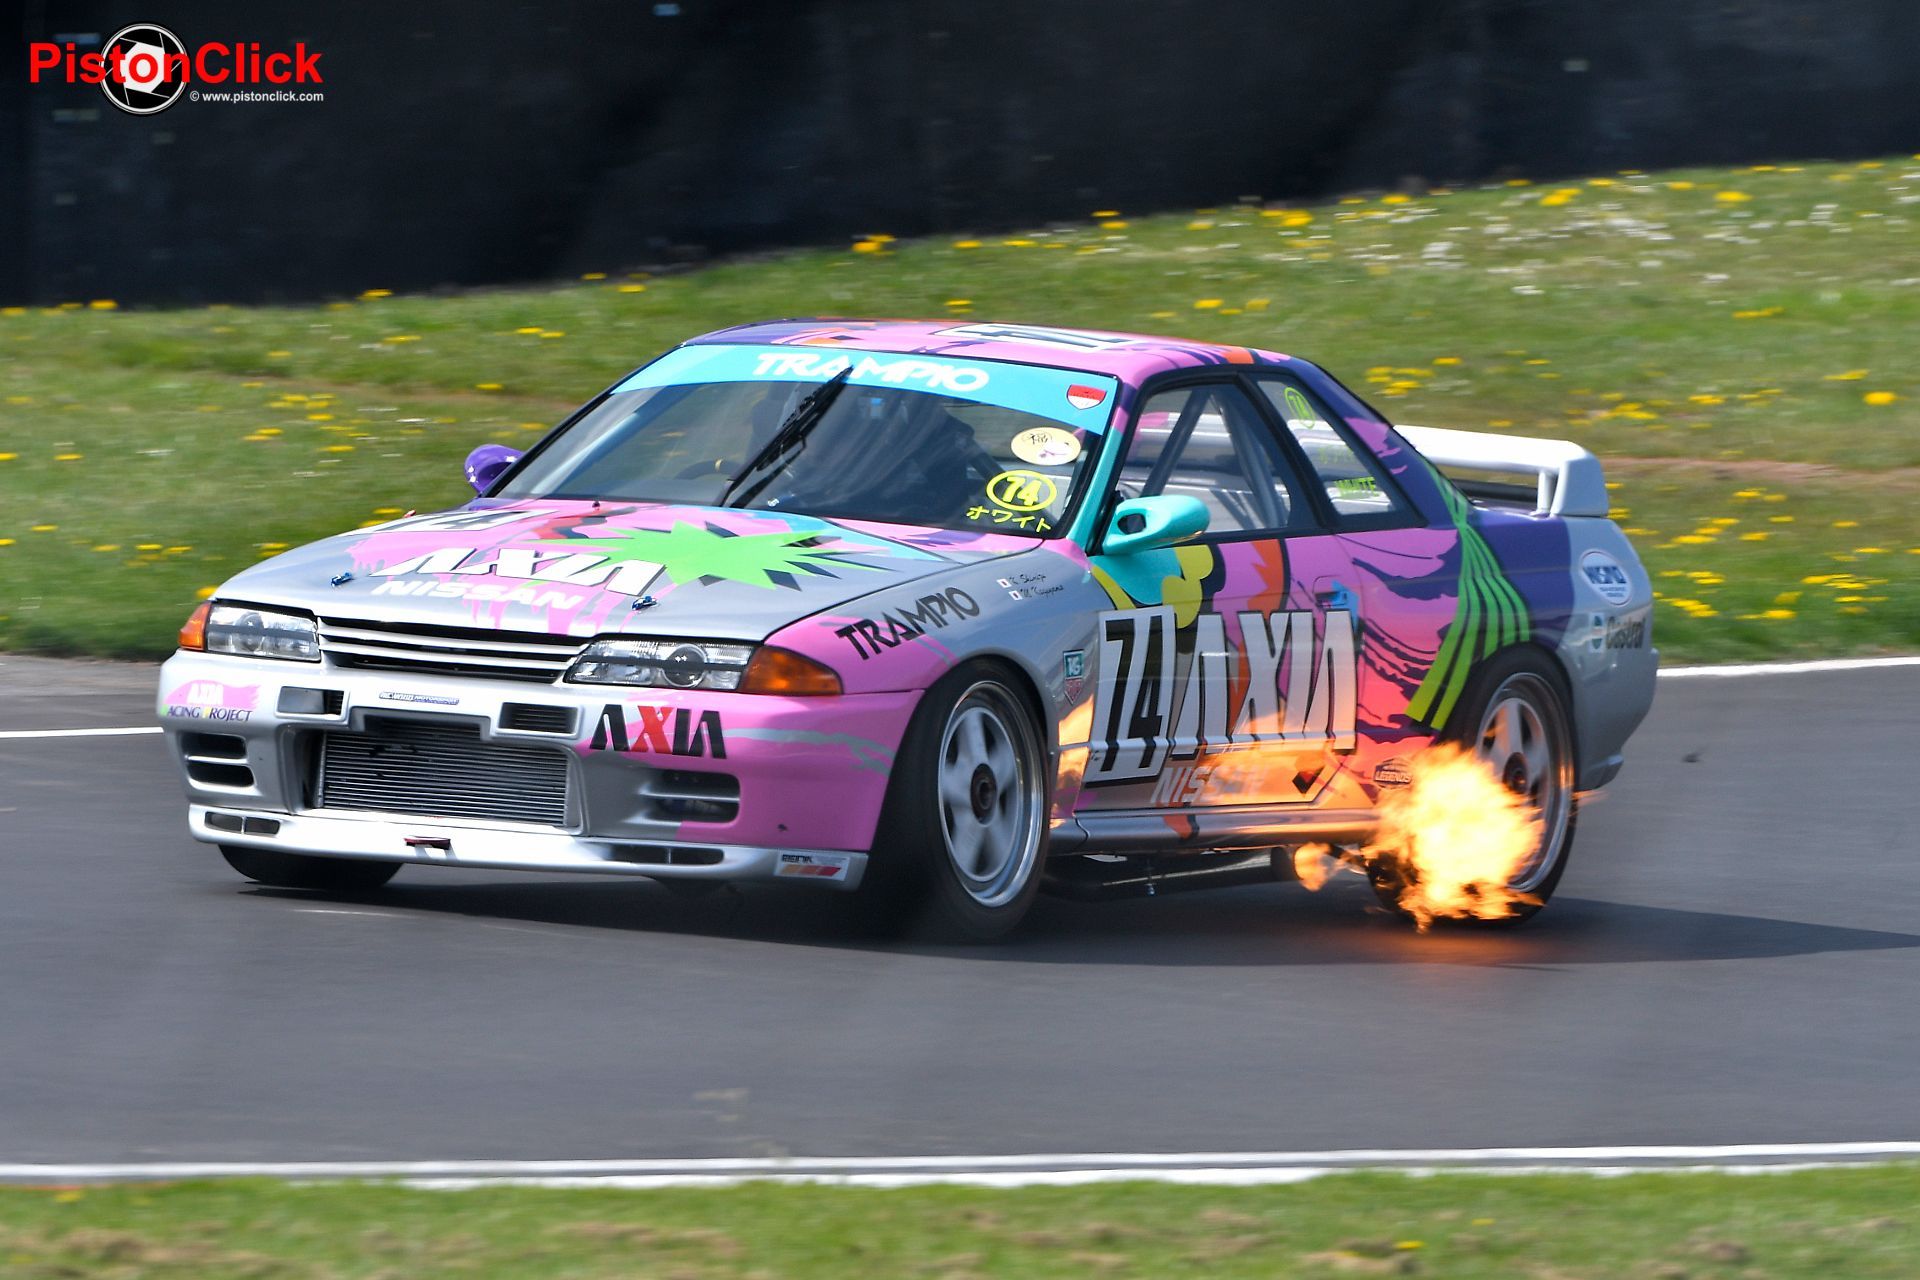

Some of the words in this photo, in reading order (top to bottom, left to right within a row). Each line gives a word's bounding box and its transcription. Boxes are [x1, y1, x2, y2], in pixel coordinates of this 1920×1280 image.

[753, 353, 989, 391] TRAMPIO
[1001, 477, 1041, 506] 74
[371, 581, 584, 610] NISSAN
[834, 587, 980, 660] TRAMPIO
[1100, 615, 1163, 772] 74
[1171, 611, 1356, 756] AXIA
[590, 704, 726, 759] AXIA
